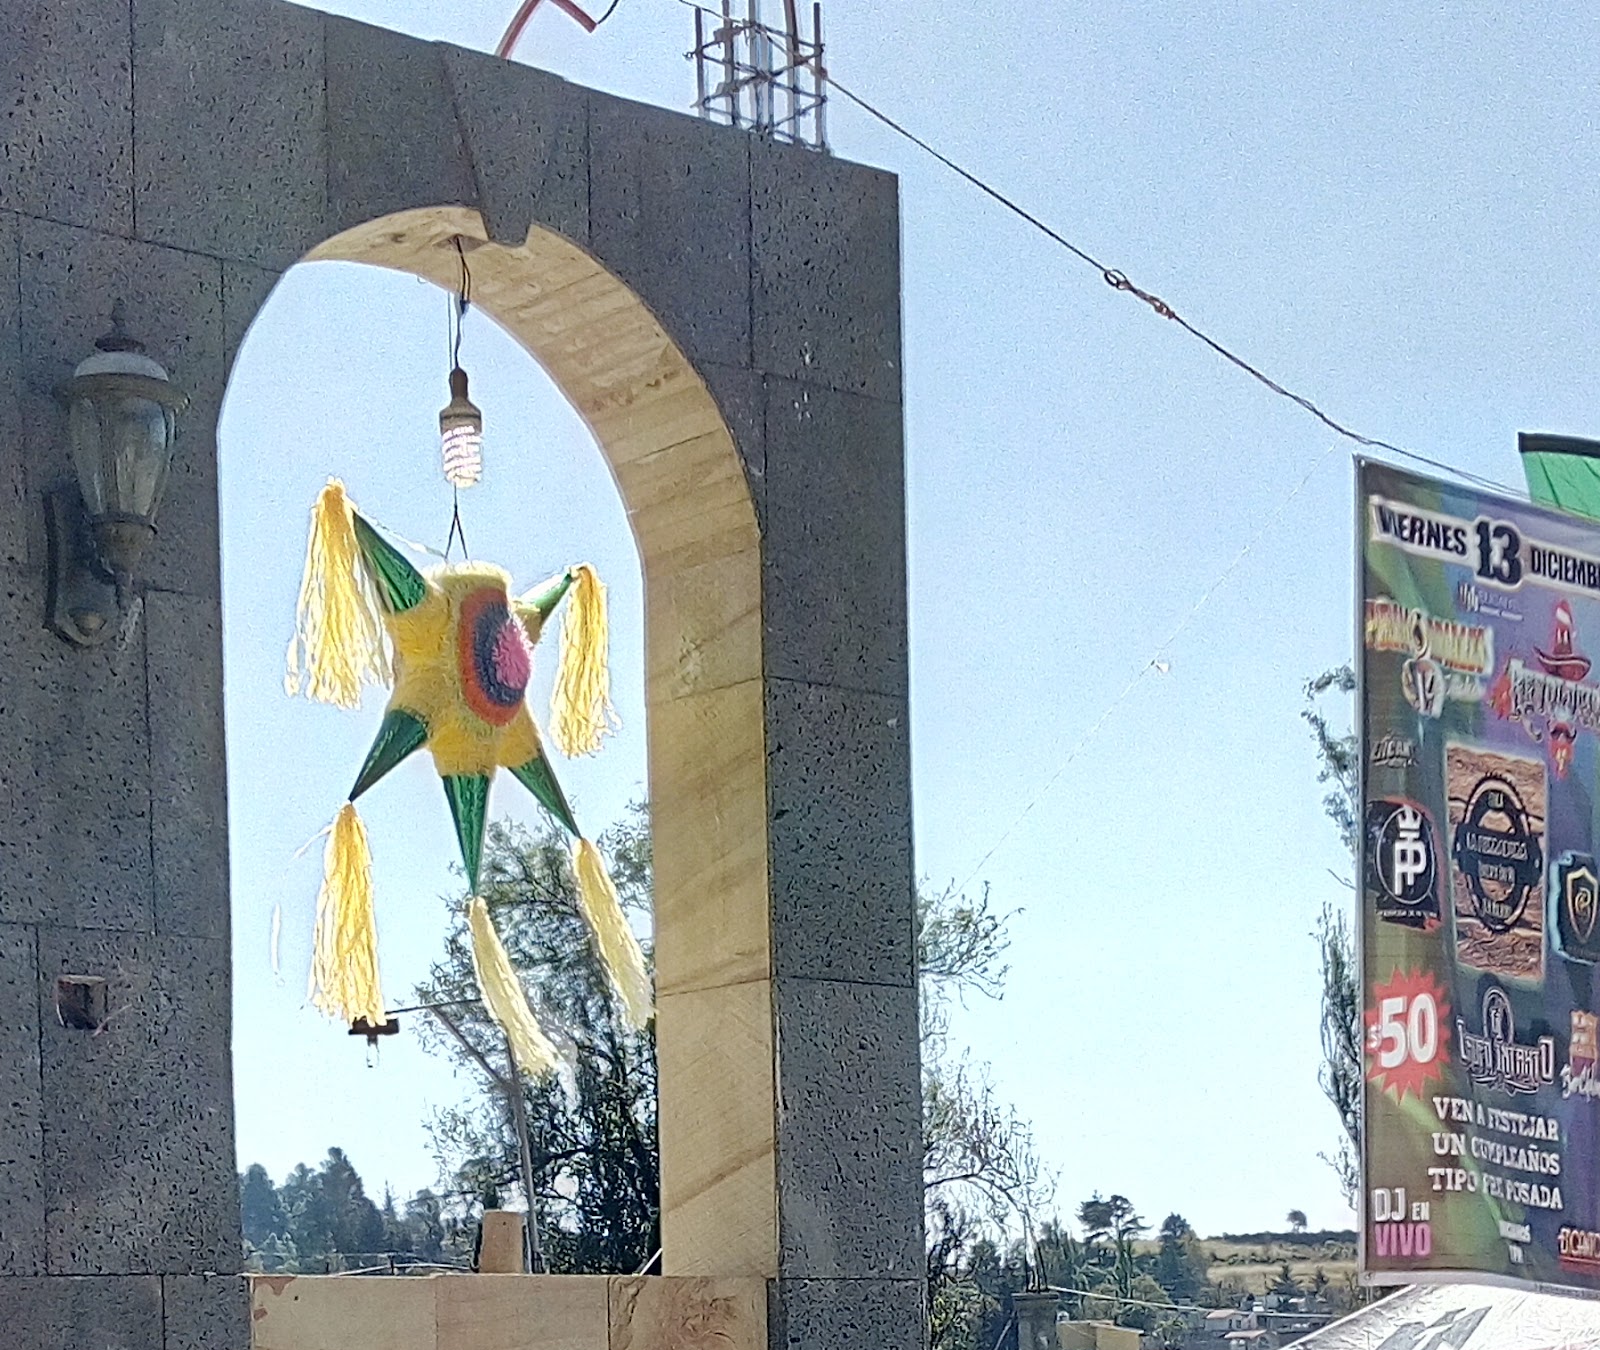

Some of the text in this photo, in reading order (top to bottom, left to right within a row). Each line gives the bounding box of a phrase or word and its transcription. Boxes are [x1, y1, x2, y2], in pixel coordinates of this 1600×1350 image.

[1377, 504, 1467, 556] VIERNES
[1476, 520, 1522, 585] 13
[1433, 1097, 1559, 1141] VEN A FESTEJAR
[1432, 1133, 1561, 1176] UN CUMPLEAÑOS
[1372, 1187, 1430, 1222] DJ EN
[1428, 1167, 1477, 1192] TIPO
[1506, 1179, 1563, 1210] POSADA
[1374, 1222, 1432, 1257] VIVO
